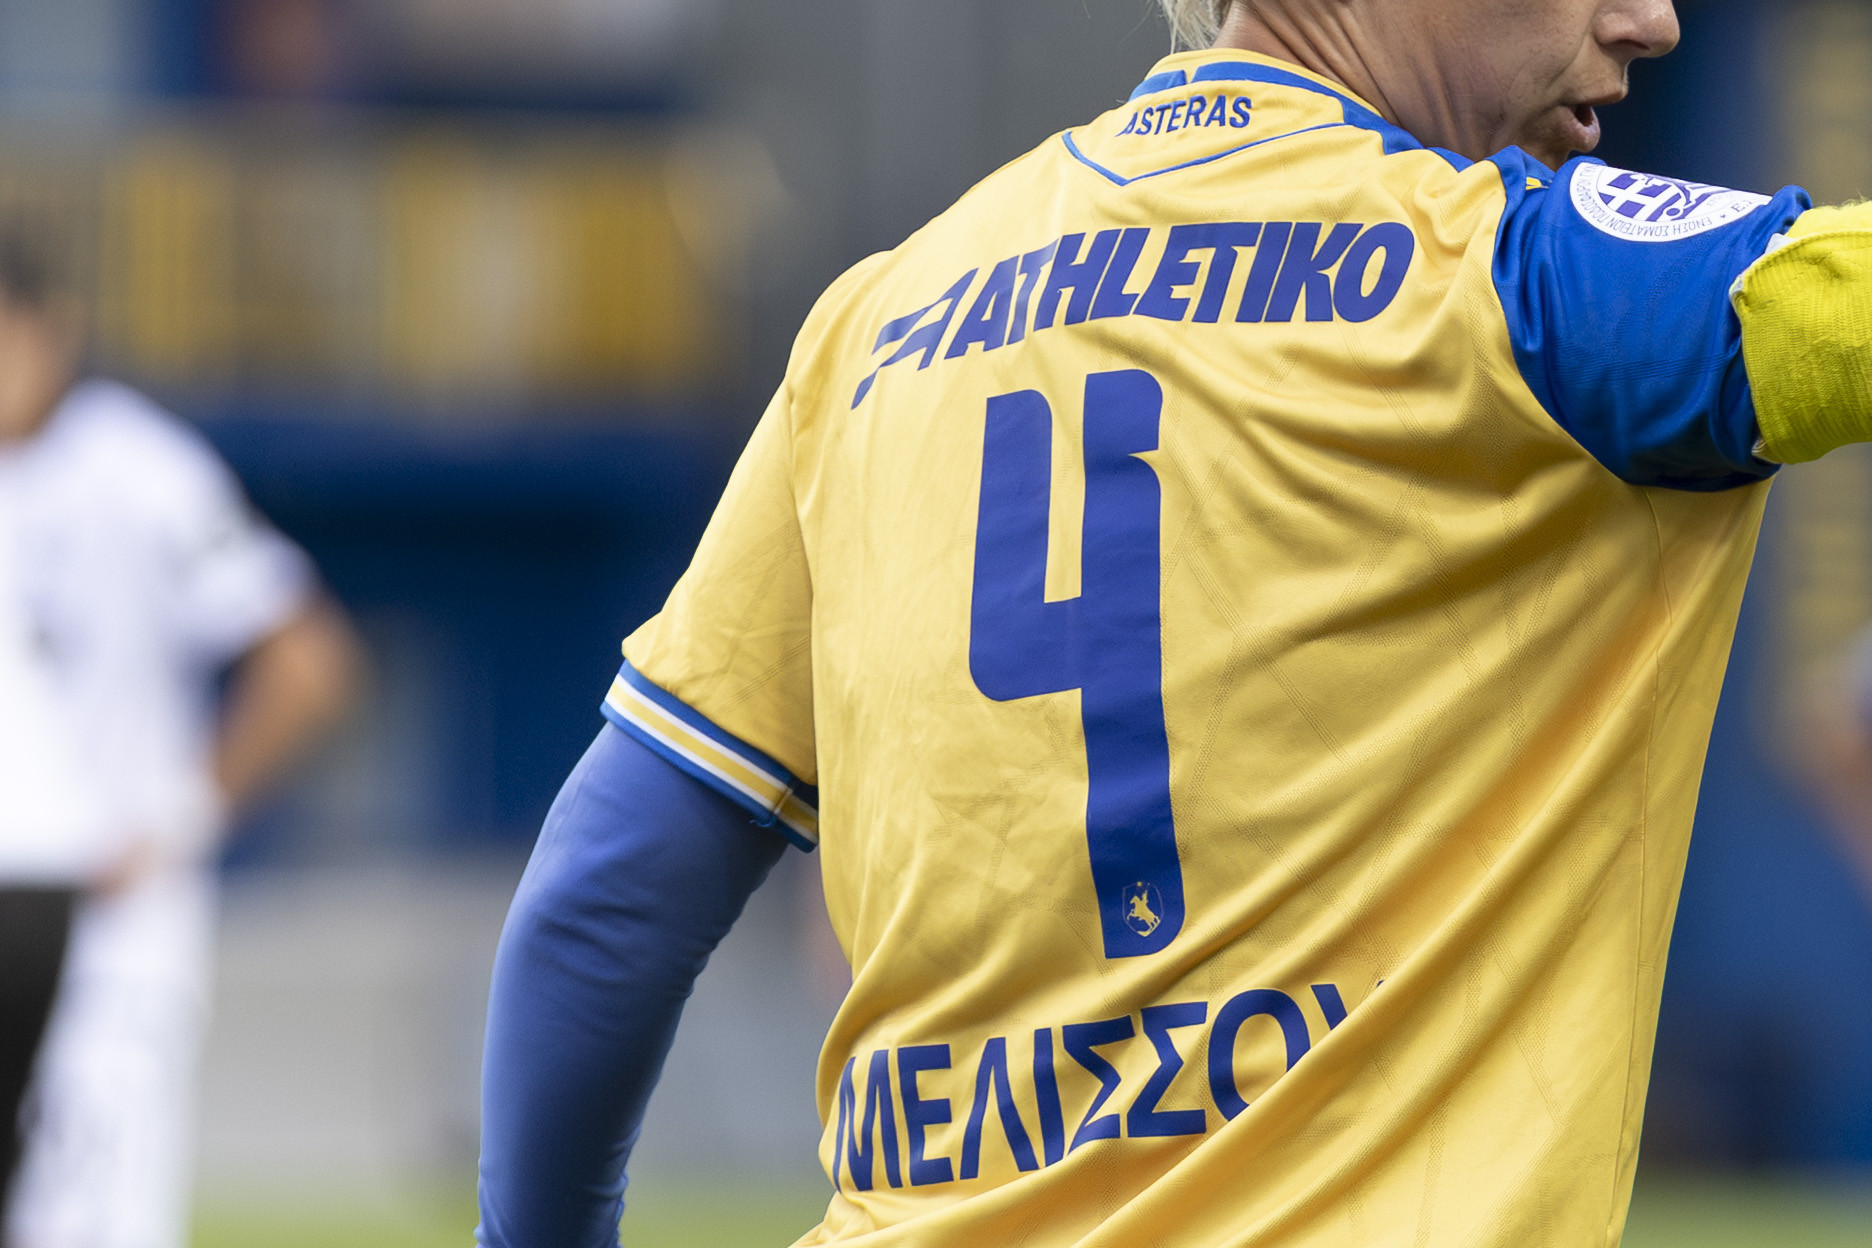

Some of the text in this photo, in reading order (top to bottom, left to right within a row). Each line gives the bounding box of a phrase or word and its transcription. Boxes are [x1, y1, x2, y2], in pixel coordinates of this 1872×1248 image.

[1114, 94, 1252, 138] ASTERAS
[943, 221, 1415, 360] ATHLETIKO
[969, 368, 1186, 960] 4
